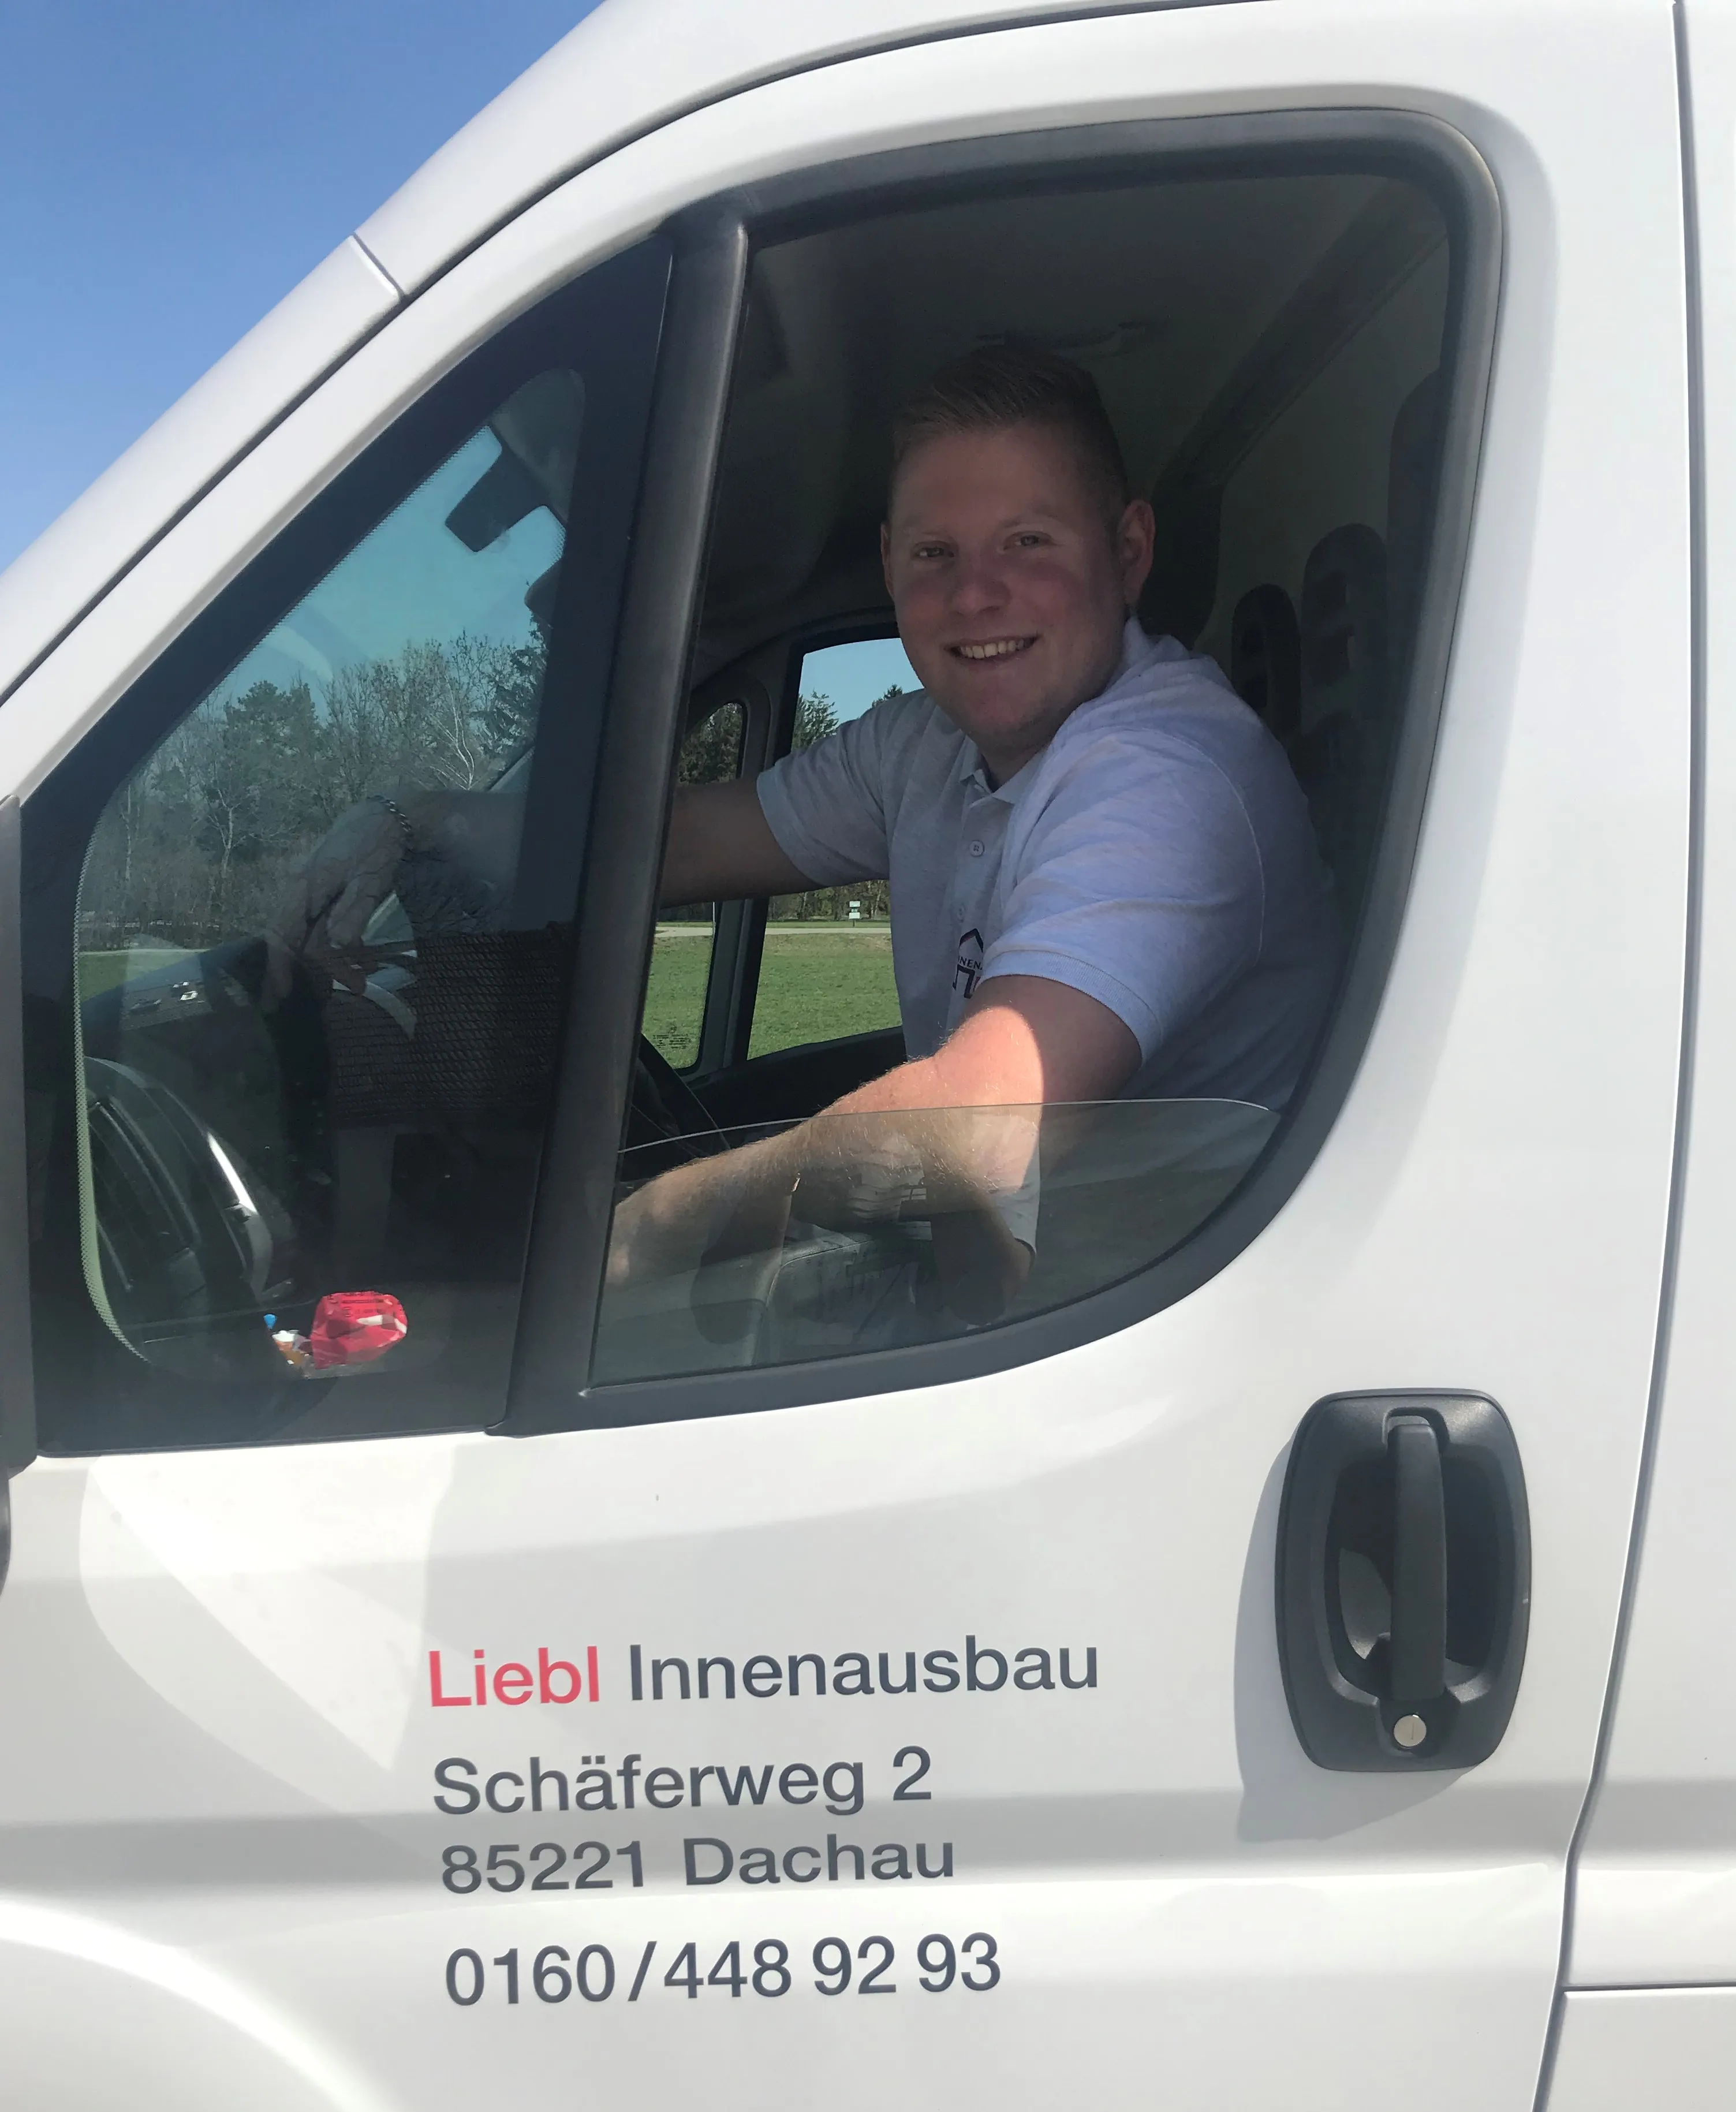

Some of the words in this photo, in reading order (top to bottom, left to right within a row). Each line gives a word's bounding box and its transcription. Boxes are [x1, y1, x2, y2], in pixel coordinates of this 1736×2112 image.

[430, 1647, 599, 1706] Liebl
[630, 1635, 1097, 1700] Innenausbau
[434, 1755, 864, 1815] Schäferweg
[893, 1746, 932, 1801] 2
[442, 1841, 644, 1894] 85221
[684, 1834, 954, 1886] Dachau
[813, 1936, 896, 1996] 92
[917, 1932, 1000, 1992] 93
